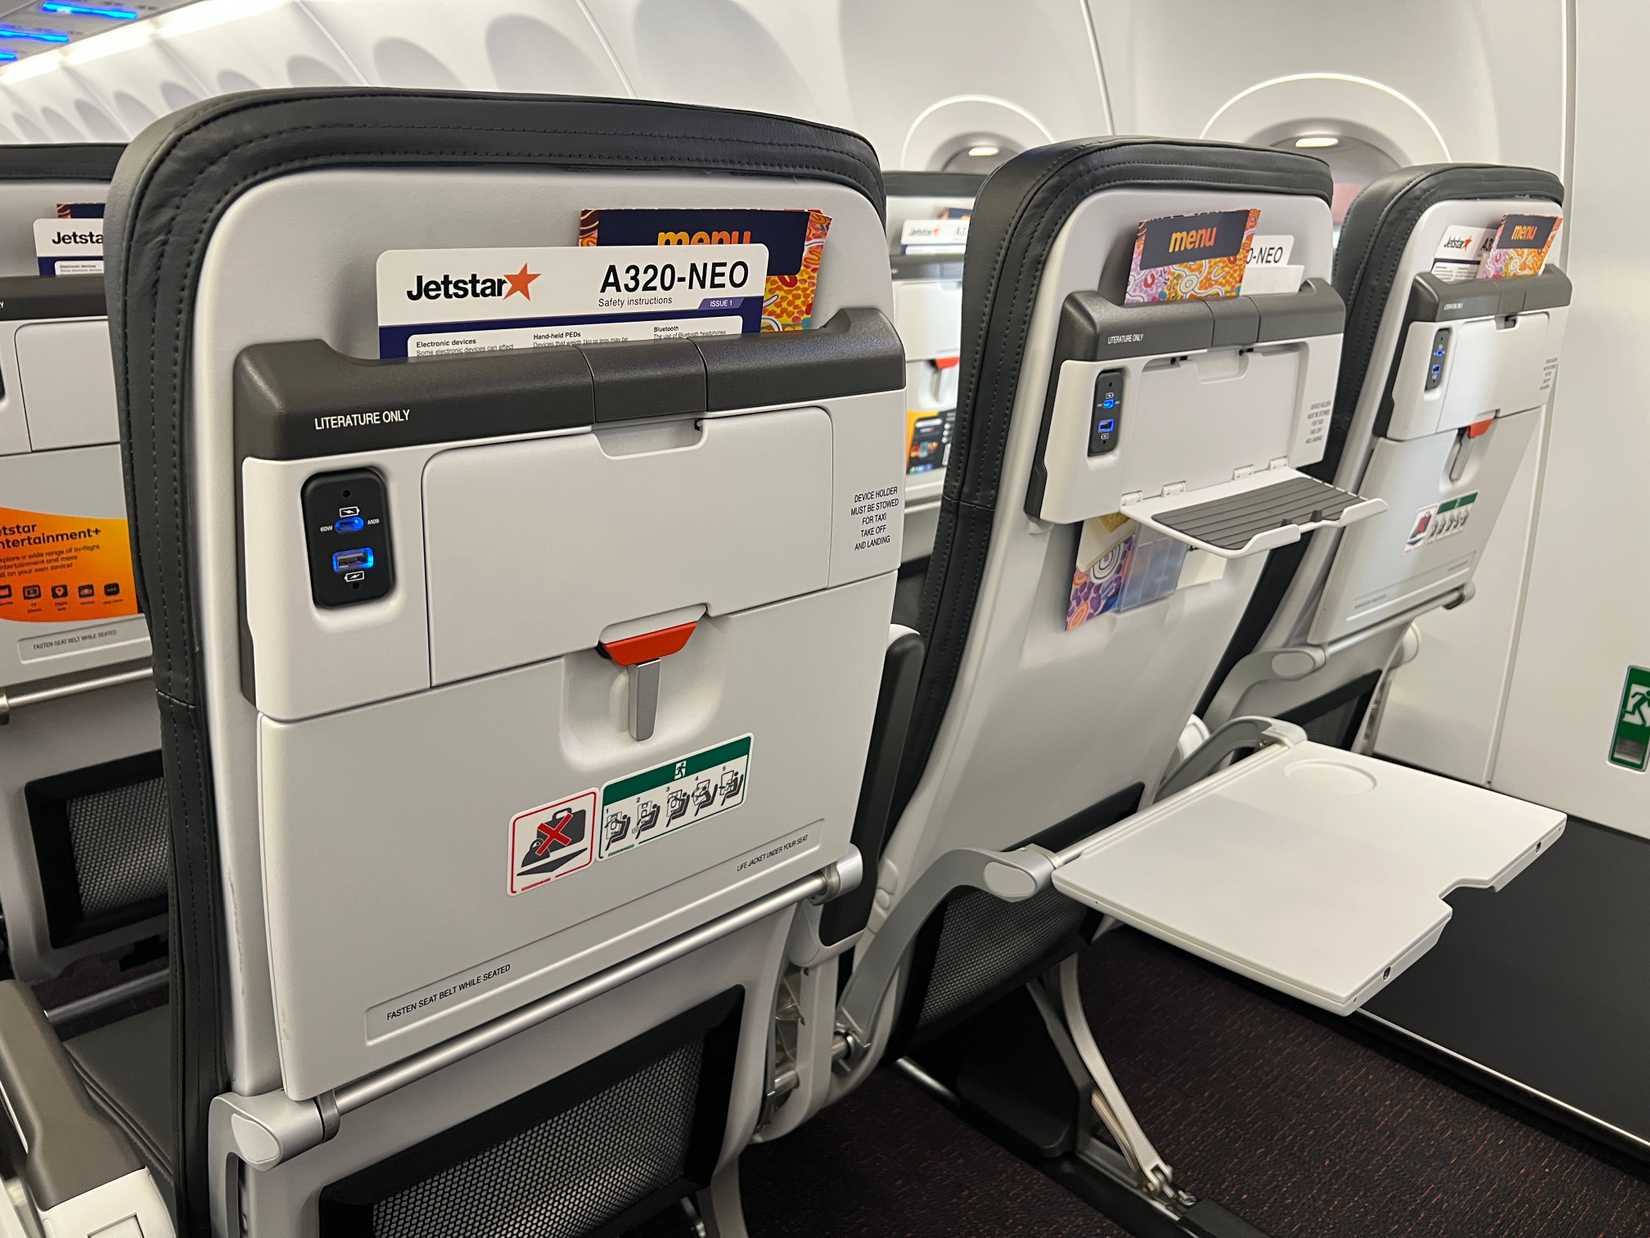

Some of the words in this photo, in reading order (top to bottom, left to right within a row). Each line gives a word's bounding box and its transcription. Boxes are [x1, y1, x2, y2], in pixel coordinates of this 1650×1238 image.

[1168, 226, 1217, 253] menu
[599, 260, 749, 293] A320-NEO
[406, 273, 508, 301] Jetstar
[598, 297, 625, 308] Safety
[627, 296, 673, 306] instructions
[416, 340, 450, 348] Electronic
[314, 411, 380, 430] LITERATURE
[382, 409, 410, 424] ONLY
[854, 490, 874, 503] DEVICE
[876, 486, 898, 498] HOLDER
[850, 505, 866, 516] MUST
[867, 504, 875, 512] BE
[876, 498, 900, 510] STOWED
[862, 516, 874, 525] FOR
[875, 512, 887, 522] TAXI
[861, 528, 875, 537] TAKE
[875, 524, 887, 534] OFF
[854, 541, 867, 551] AND
[867, 535, 891, 548] LANDING
[736, 861, 748, 872] LIFE
[748, 853, 766, 867] JACKET
[766, 846, 783, 858] UNDER
[783, 840, 796, 850] YOUR
[796, 834, 809, 845] SEAT
[386, 1002, 417, 1021] FASTEN
[418, 994, 438, 1008] SEAT
[439, 986, 458, 1000] BELT
[458, 976, 482, 992] WHILE
[483, 964, 511, 982] SEATED
